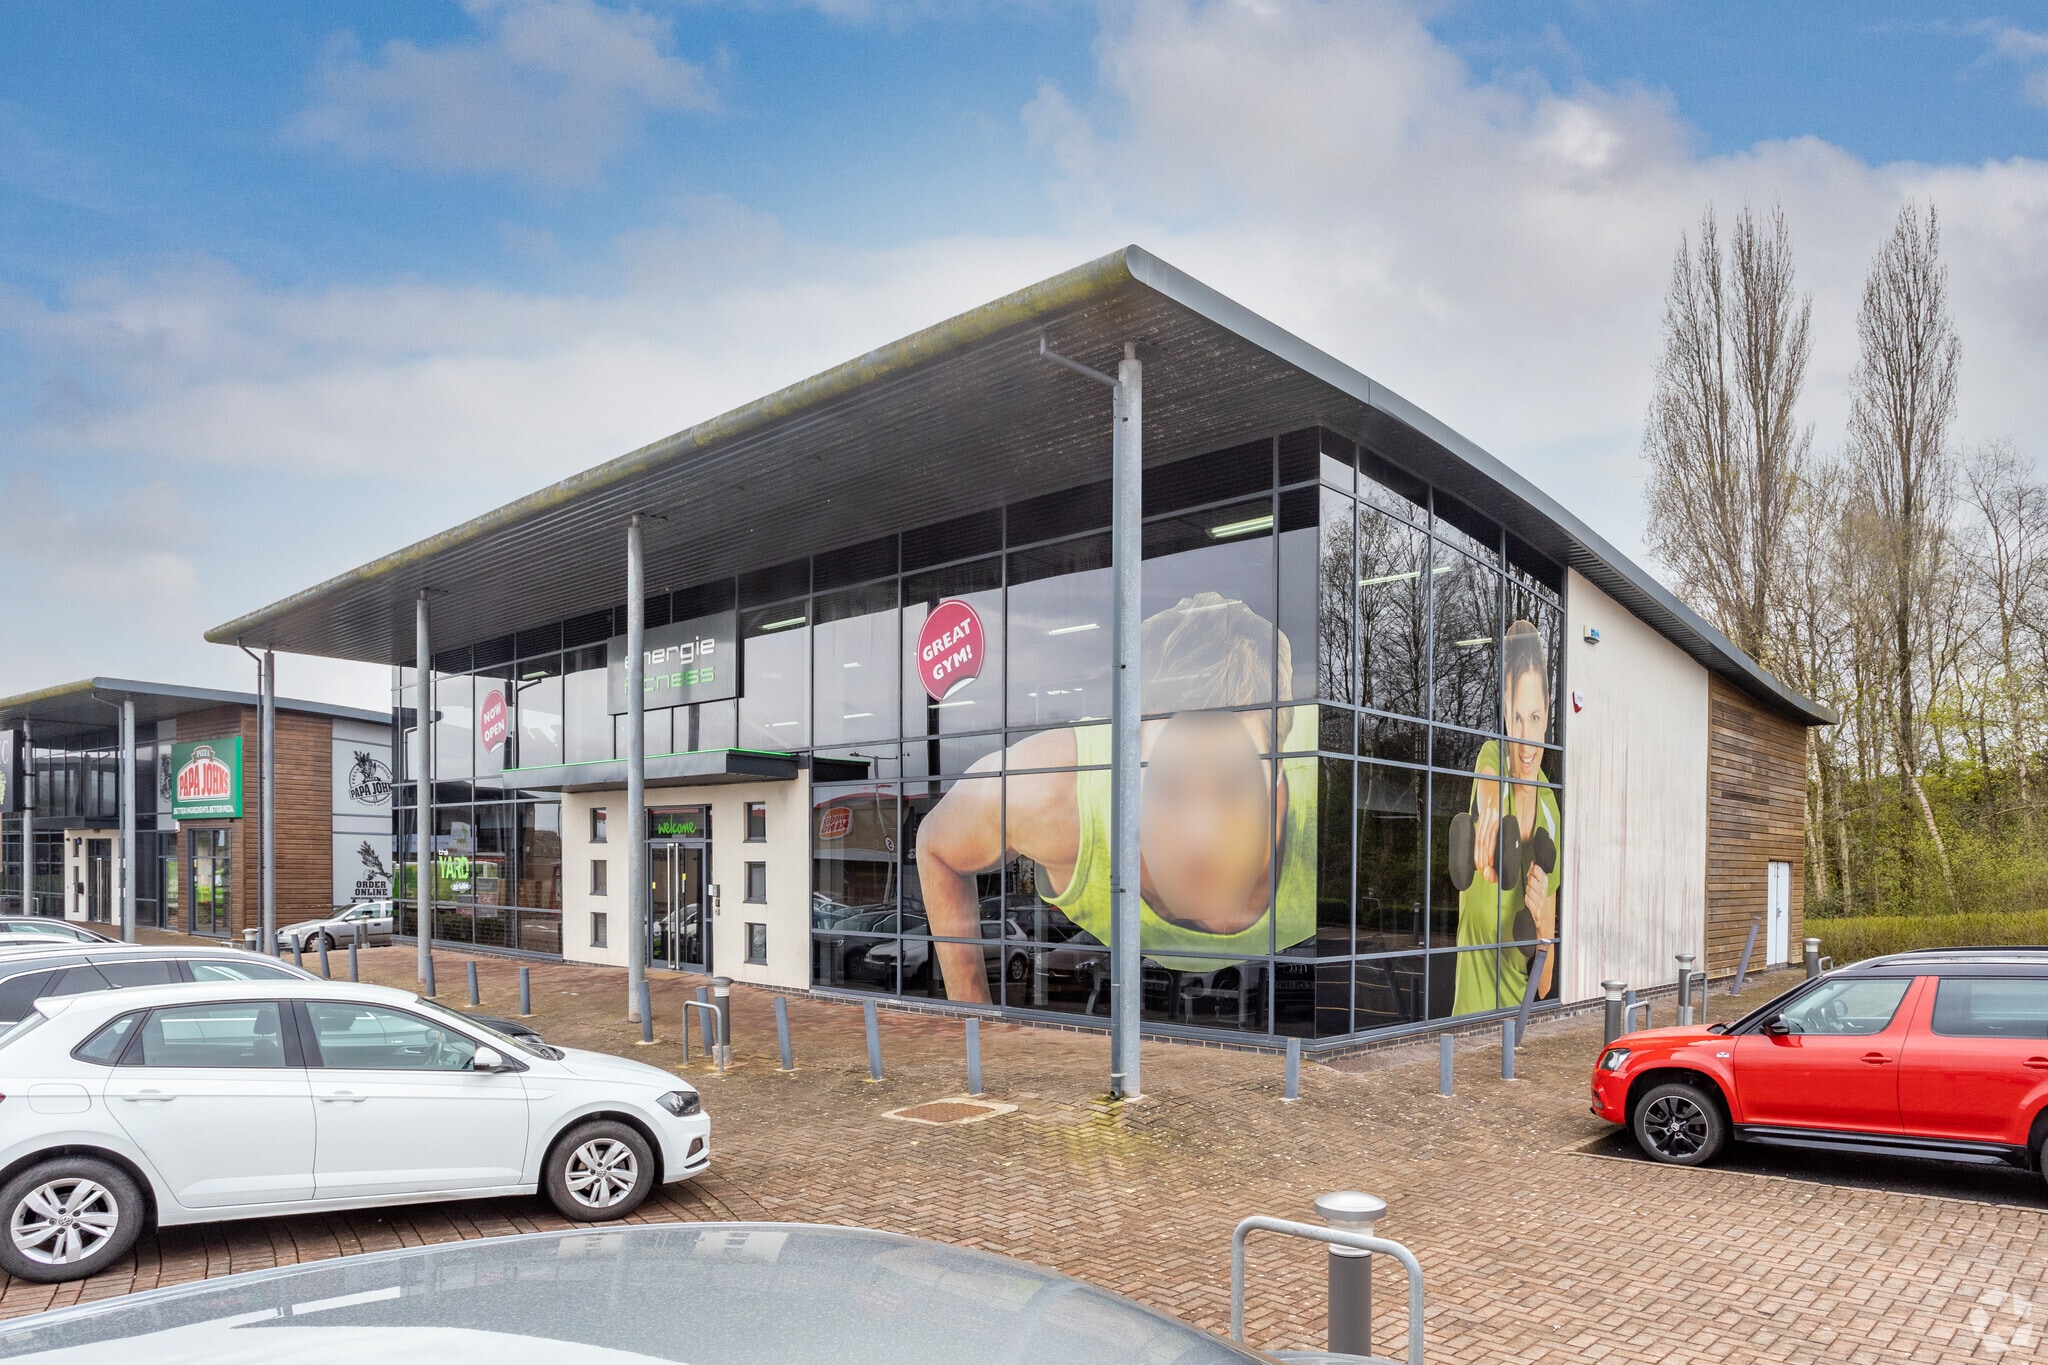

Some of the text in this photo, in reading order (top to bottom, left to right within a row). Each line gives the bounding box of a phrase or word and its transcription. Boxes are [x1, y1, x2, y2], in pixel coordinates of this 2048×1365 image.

[922, 617, 971, 662] GREAT
[624, 635, 715, 670] nergie
[932, 644, 973, 680] GYM!
[624, 666, 715, 695] ftness
[483, 702, 501, 725] NOW
[484, 718, 505, 742] OPEN
[180, 763, 229, 796] PAPA JOHNS
[350, 782, 392, 798] PAPA JOHN
[657, 813, 697, 835] welcome
[438, 855, 470, 880] YARD
[354, 888, 388, 896] ONLINE
[356, 880, 387, 889] ORDER
